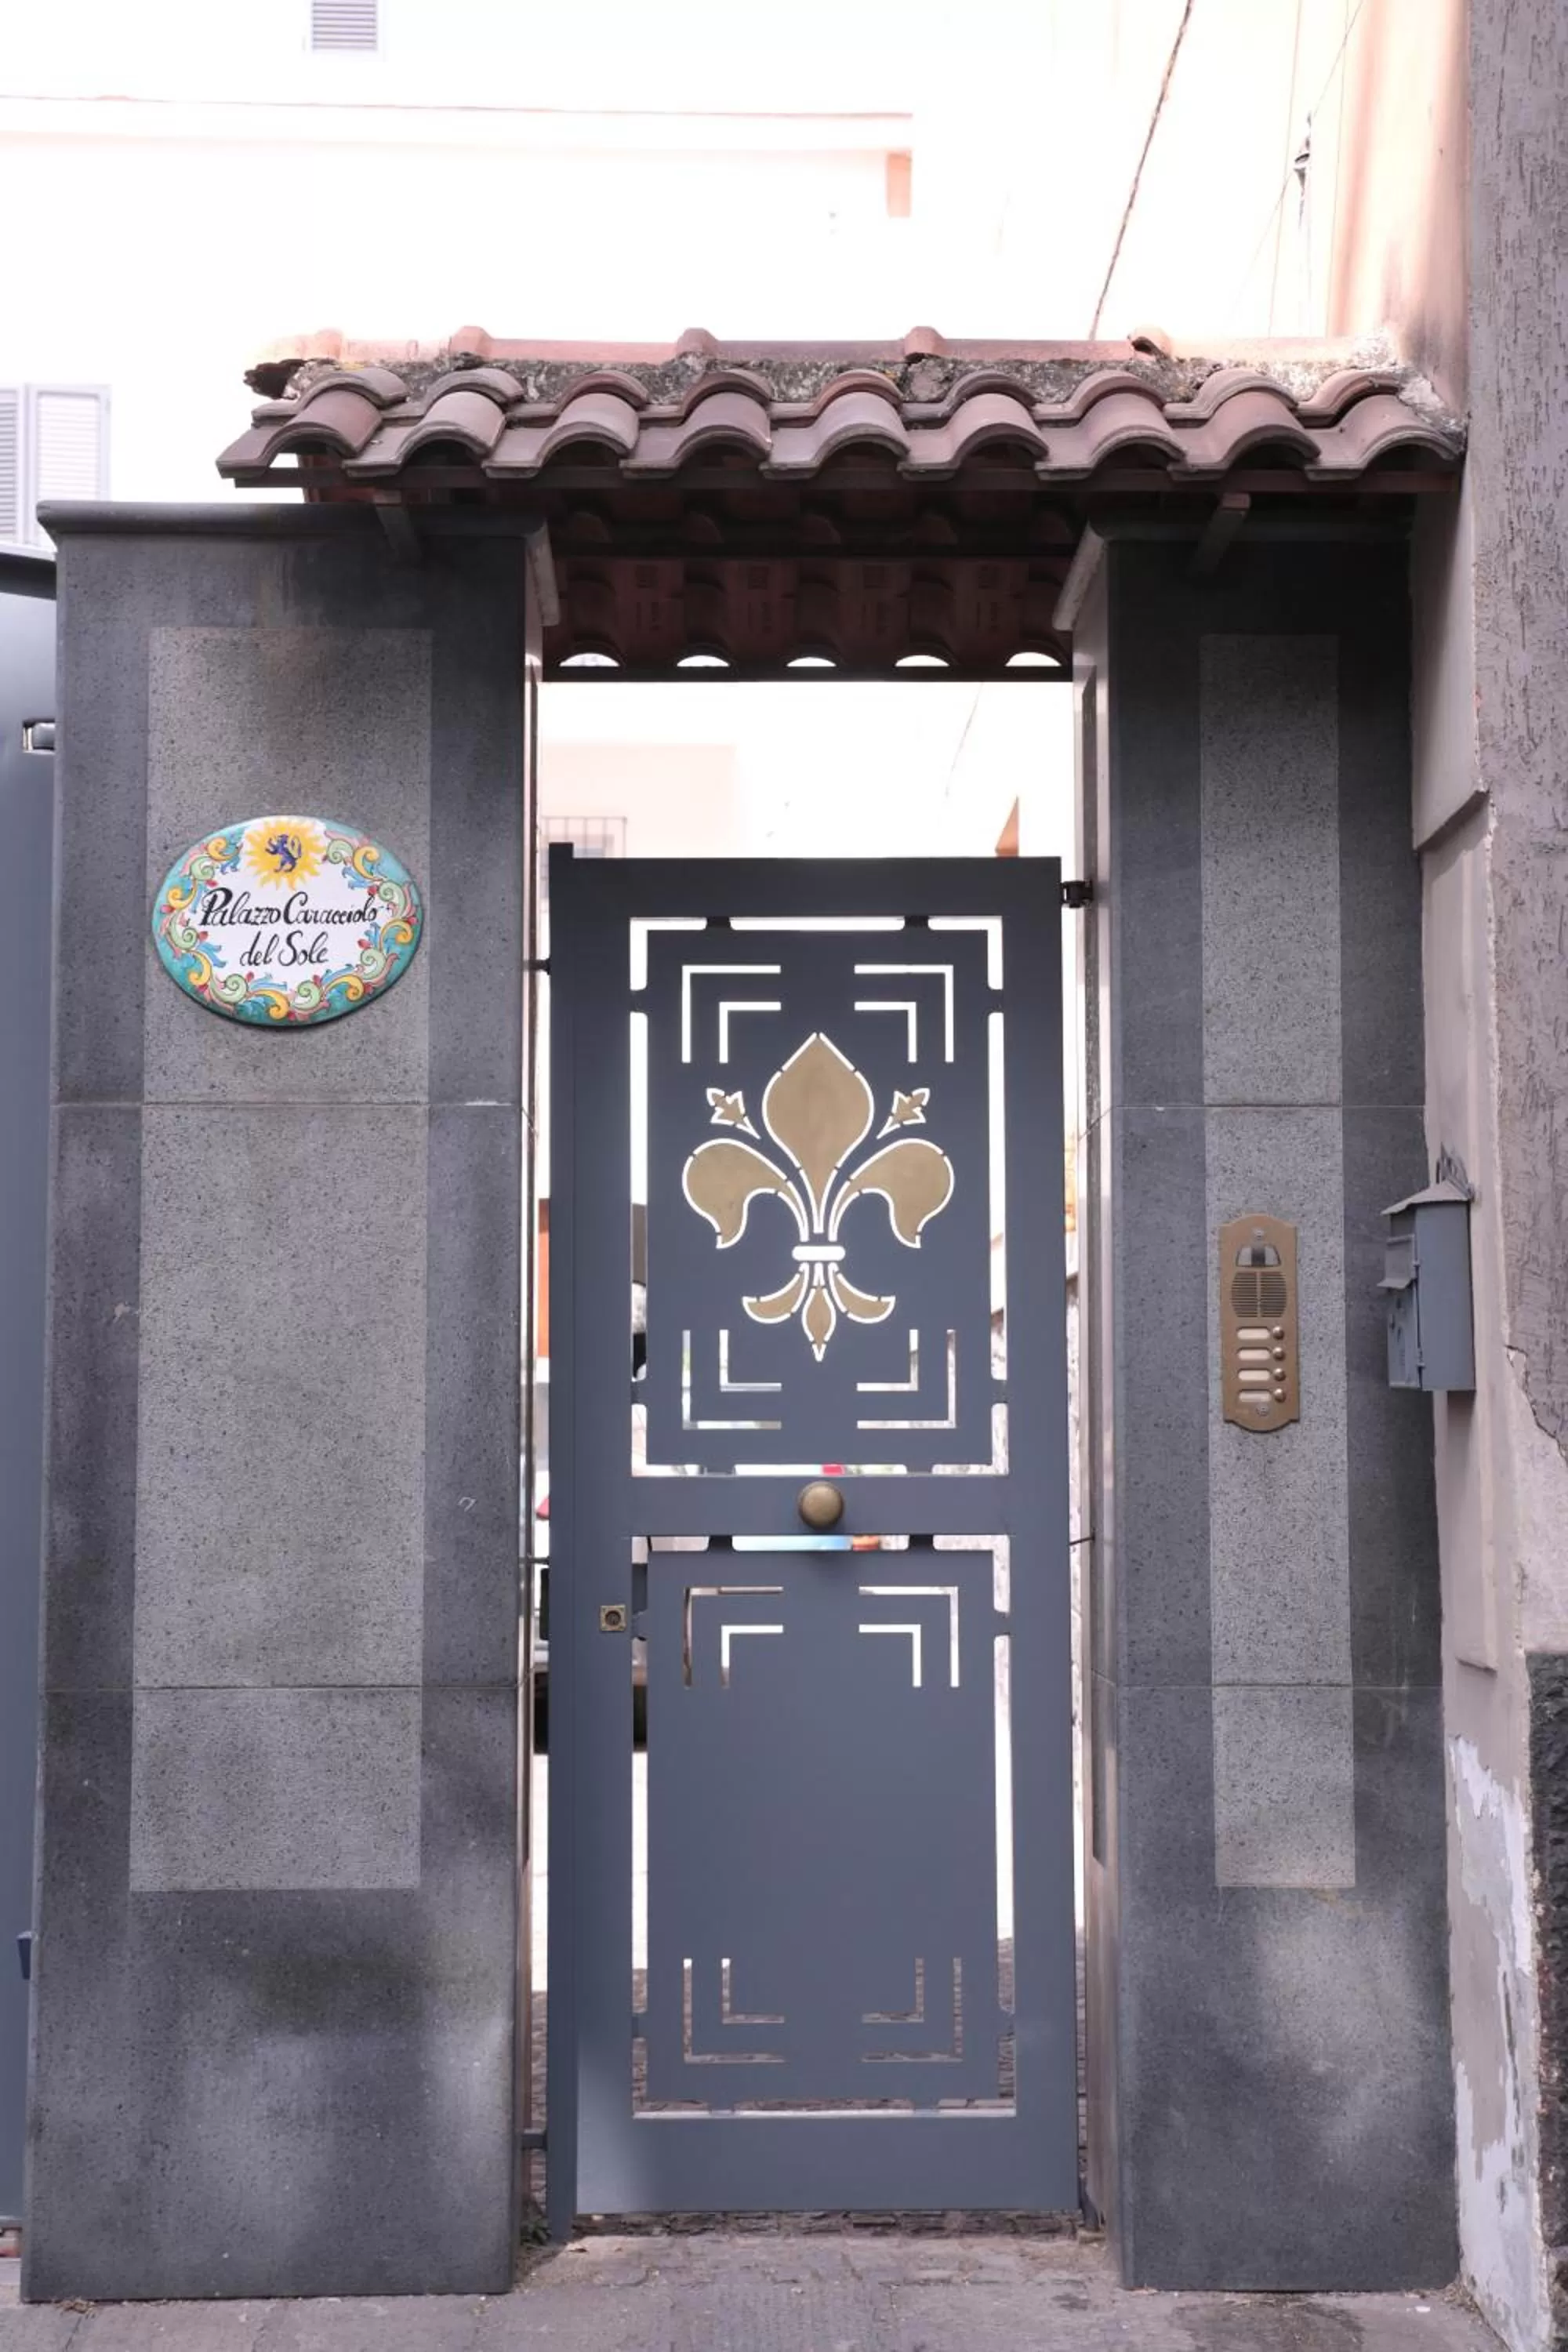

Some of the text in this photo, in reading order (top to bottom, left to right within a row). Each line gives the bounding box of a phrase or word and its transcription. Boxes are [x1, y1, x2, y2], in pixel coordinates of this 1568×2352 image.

[198, 887, 377, 926] Palazzo Caracciolo
[239, 930, 328, 967] del Sole
